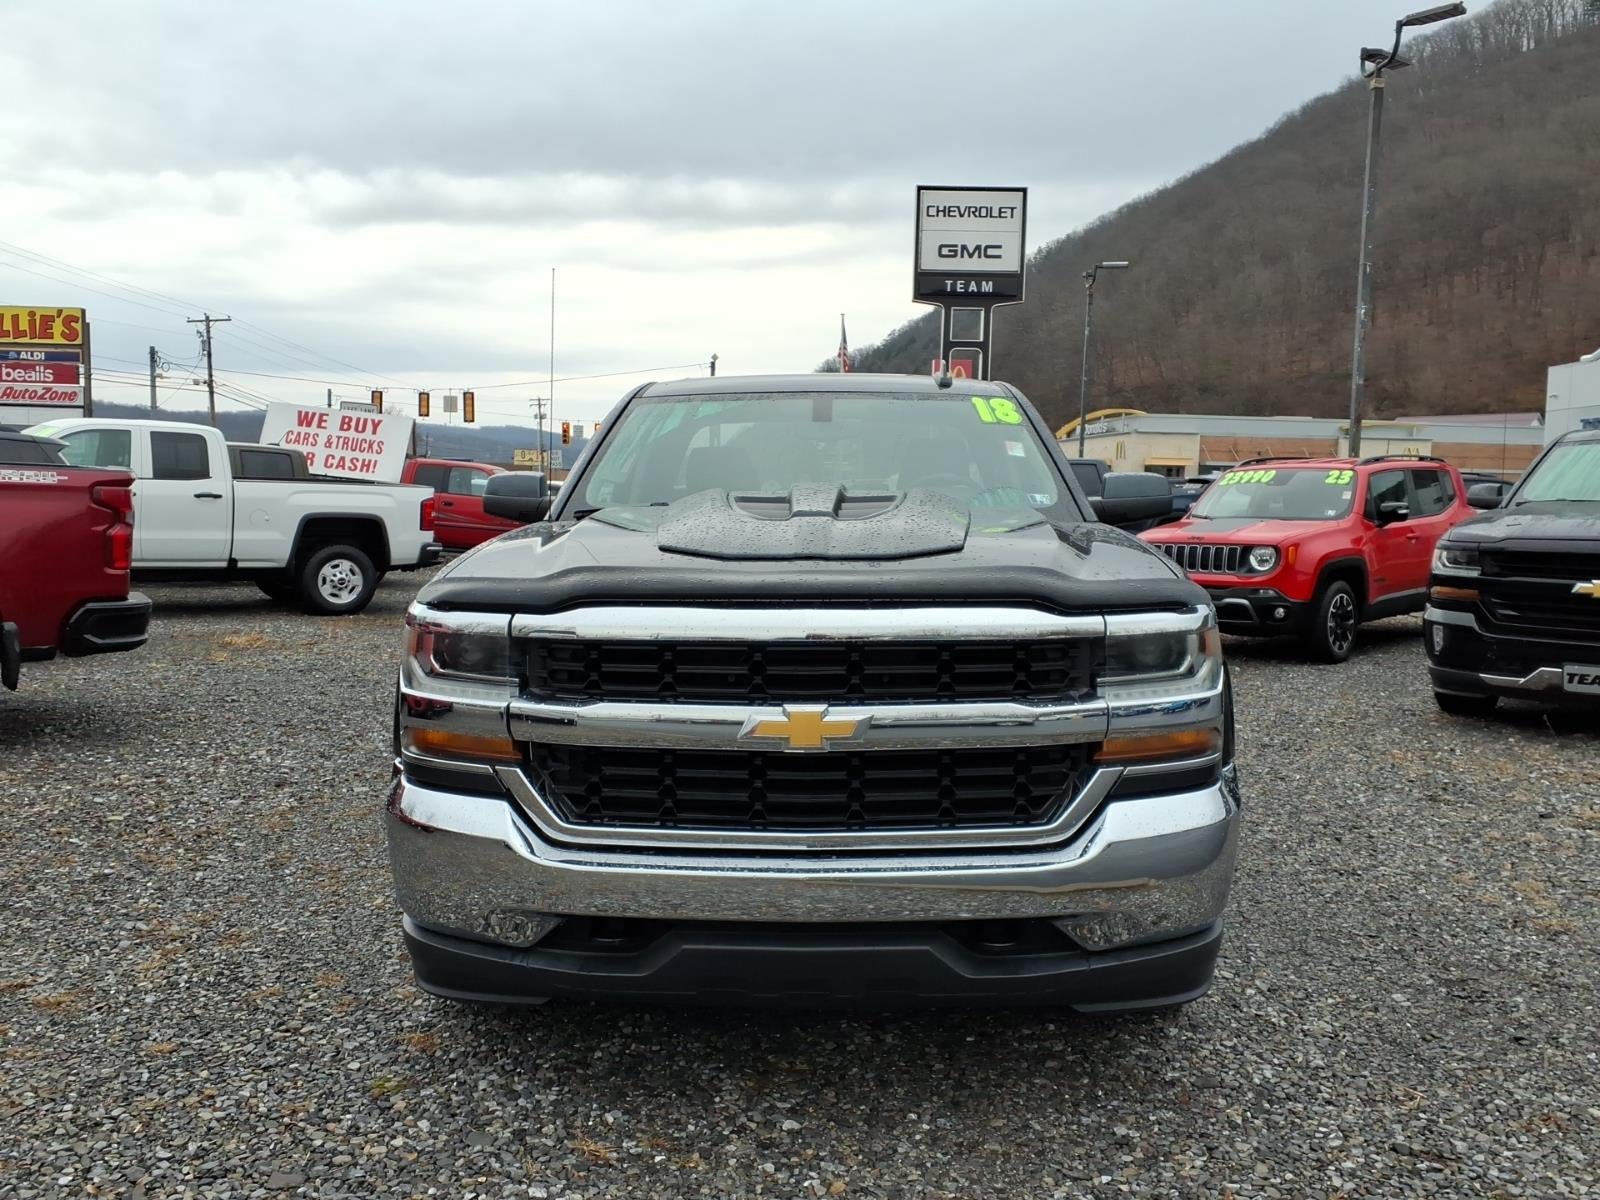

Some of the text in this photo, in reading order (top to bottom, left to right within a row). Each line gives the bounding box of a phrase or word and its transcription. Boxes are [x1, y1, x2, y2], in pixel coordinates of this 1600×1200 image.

[926, 205, 1017, 219] CHEVROLET
[938, 244, 1002, 259] GMC
[945, 280, 993, 292] TEAM
[20, 351, 45, 360] ALDI
[1, 364, 54, 381] bealls
[0, 386, 79, 402] AutoZone
[971, 396, 1022, 424] 18
[297, 410, 383, 436] WE BUY
[285, 430, 319, 447] CARS
[323, 454, 378, 474] CASH!
[1325, 470, 1354, 485] 23
